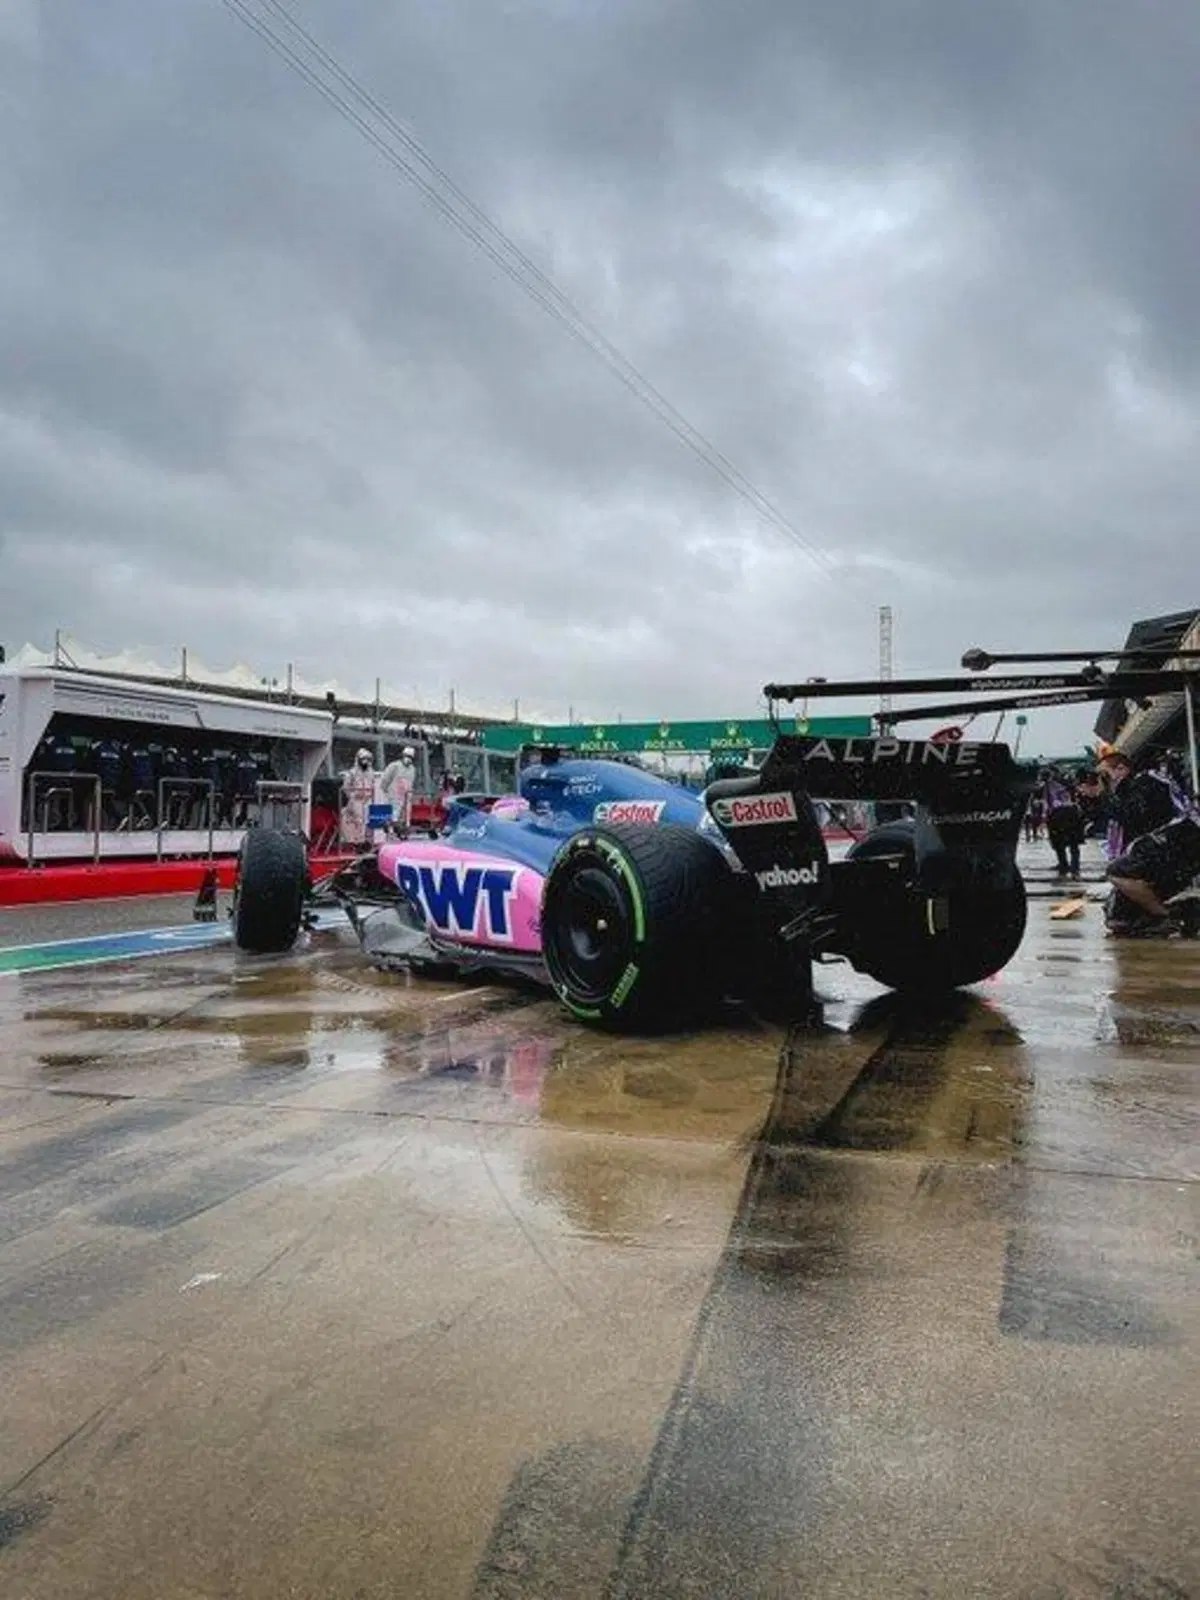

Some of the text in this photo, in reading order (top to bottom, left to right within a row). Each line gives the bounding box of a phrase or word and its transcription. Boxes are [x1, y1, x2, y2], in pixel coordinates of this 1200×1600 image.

[580, 741, 619, 752] ROLEX
[644, 739, 685, 750] ROLEX
[711, 738, 754, 749] ROLEX
[803, 739, 981, 765] ALPINE
[608, 801, 660, 823] Castrol
[732, 799, 791, 823] Castrol
[755, 861, 819, 891] yahoo!
